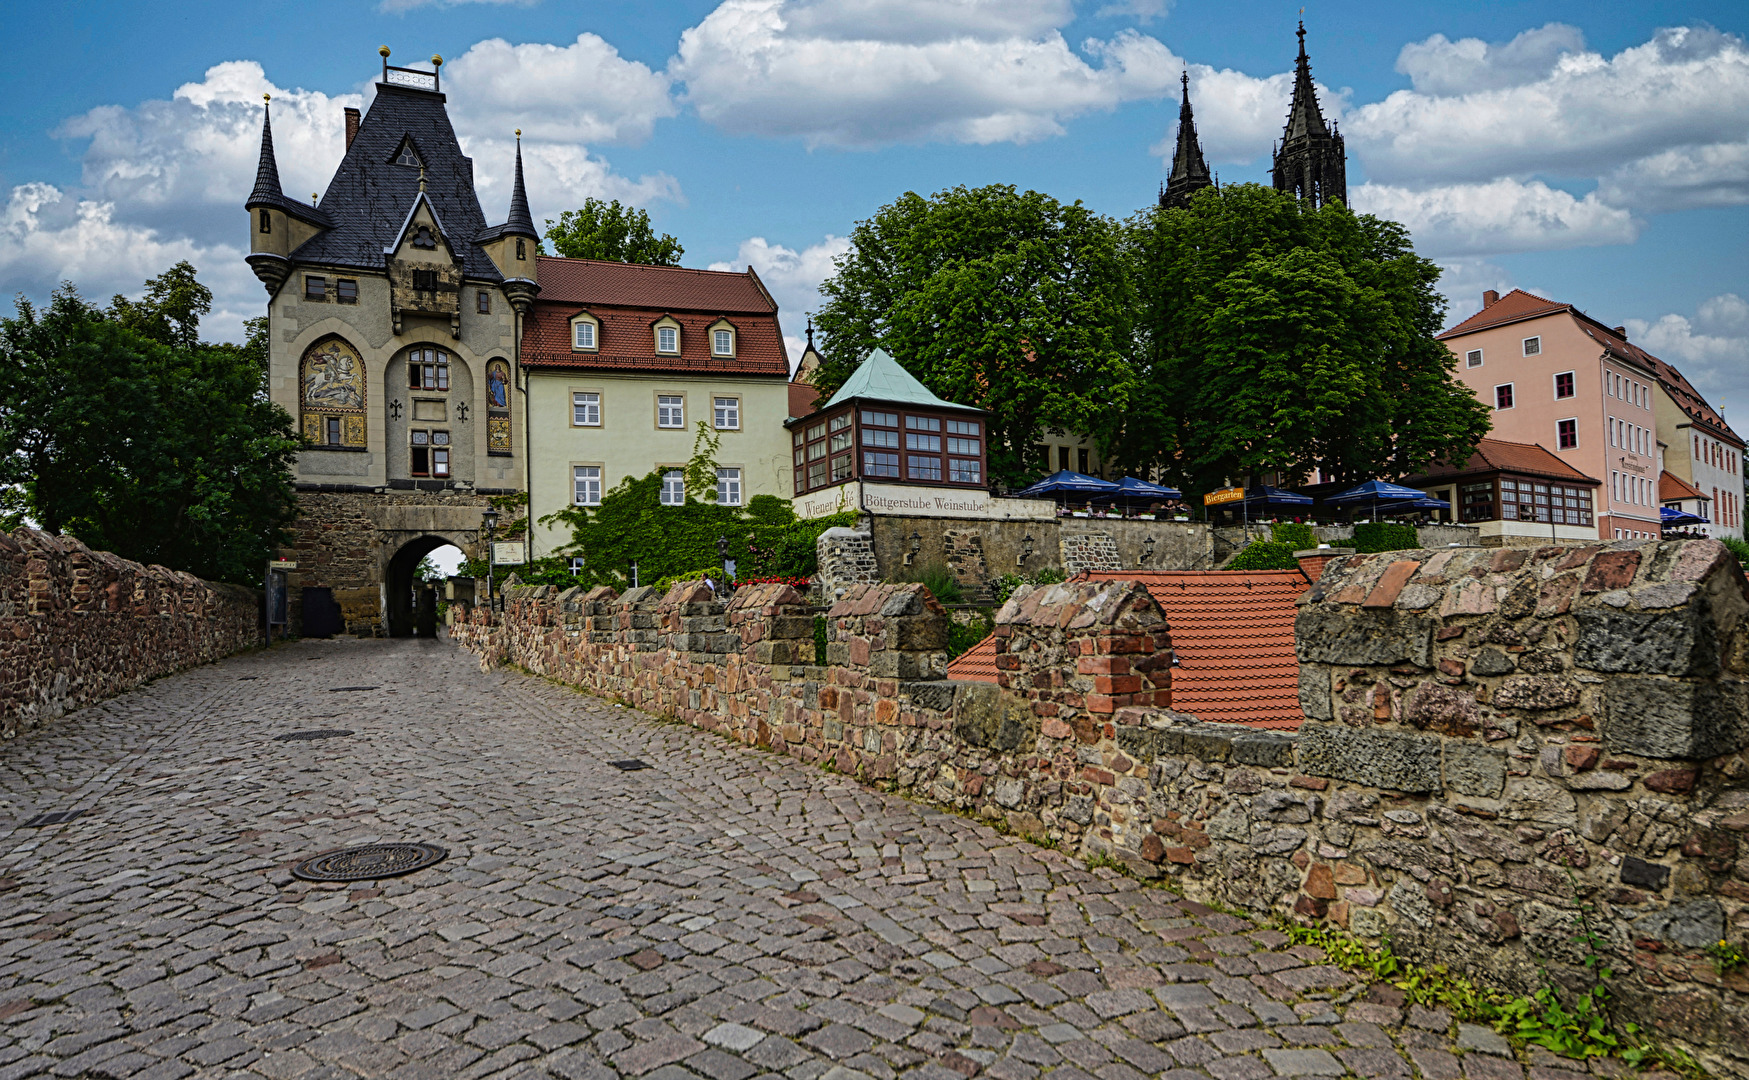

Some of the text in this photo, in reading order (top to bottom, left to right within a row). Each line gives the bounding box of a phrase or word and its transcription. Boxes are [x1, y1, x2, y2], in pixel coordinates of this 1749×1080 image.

[865, 494, 984, 512] Böttgerstube Weinstube
[1205, 491, 1242, 503] Biergarten
[805, 500, 833, 517] Wiener
